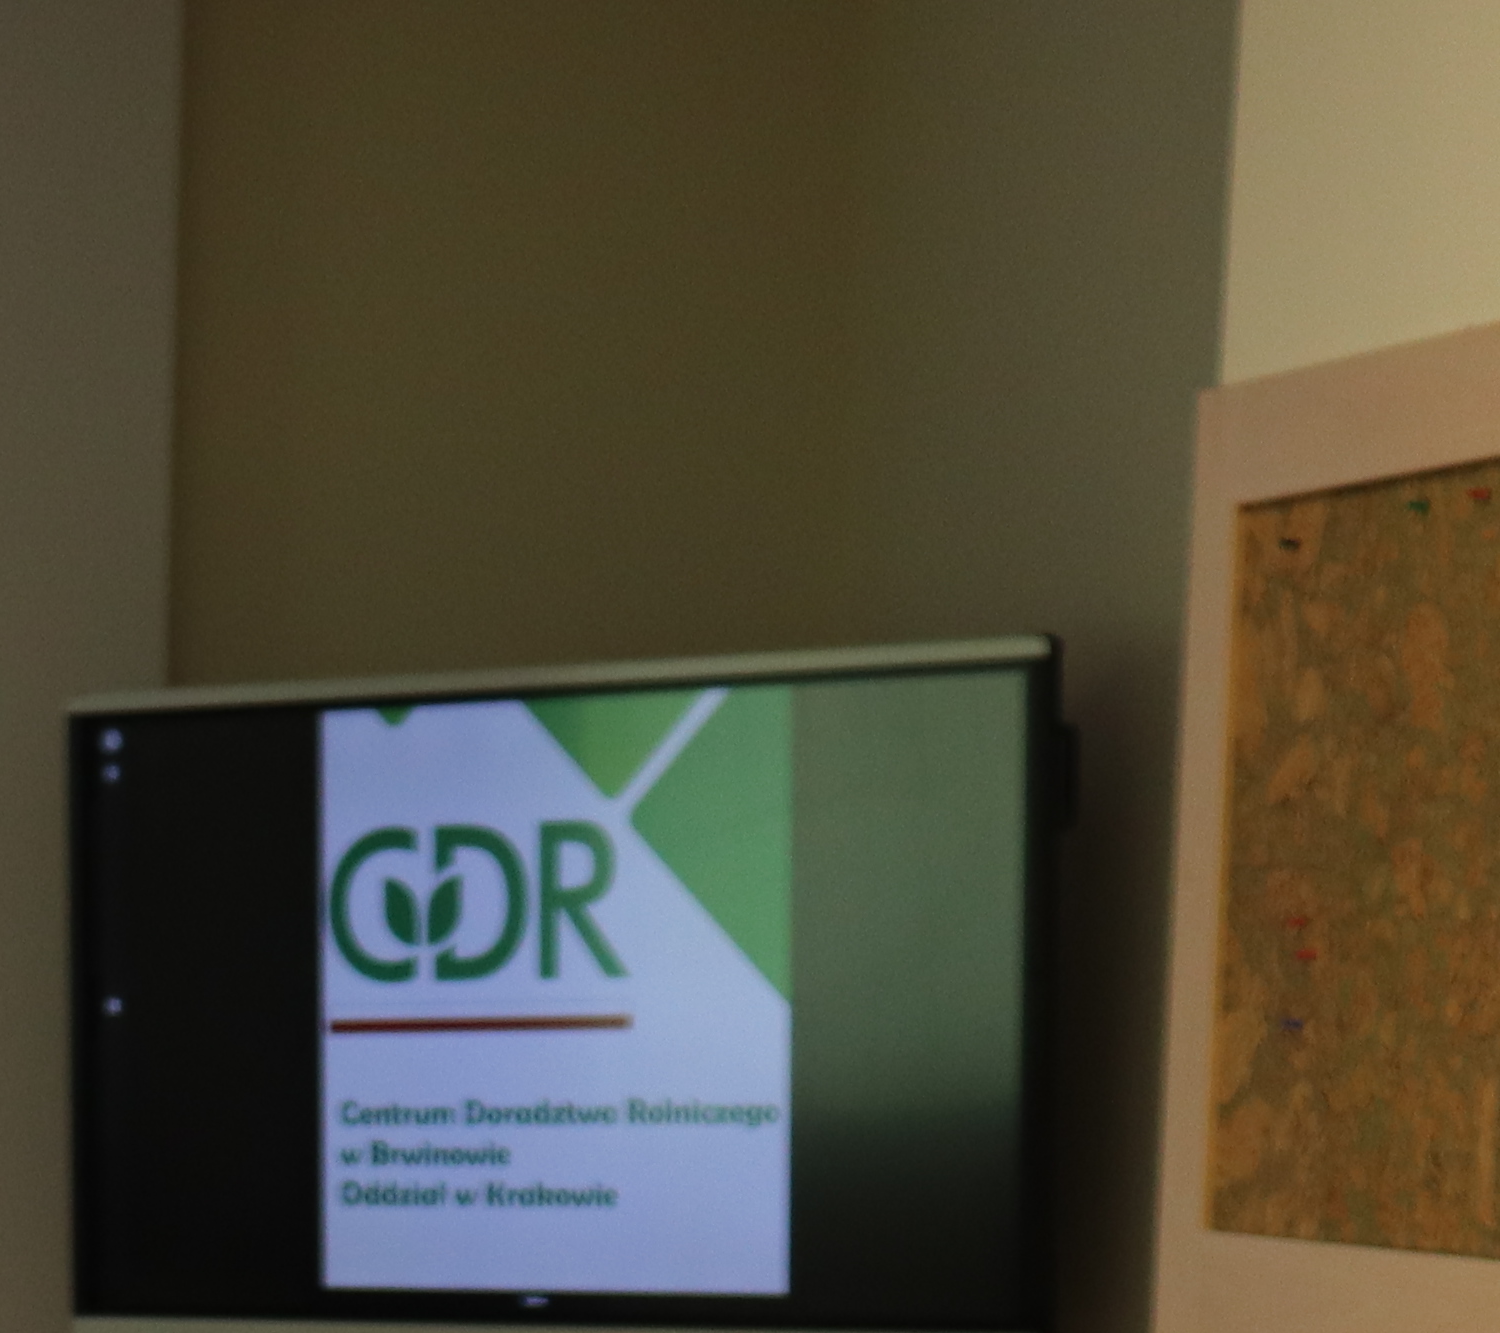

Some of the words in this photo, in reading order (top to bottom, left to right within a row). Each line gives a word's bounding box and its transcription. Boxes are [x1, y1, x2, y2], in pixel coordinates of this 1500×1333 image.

[340, 1100, 455, 1126] Centrum
[627, 1098, 779, 1128] Rolniczego
[370, 1141, 511, 1166] Brwinowie
[486, 1179, 619, 1206] Krakowie
